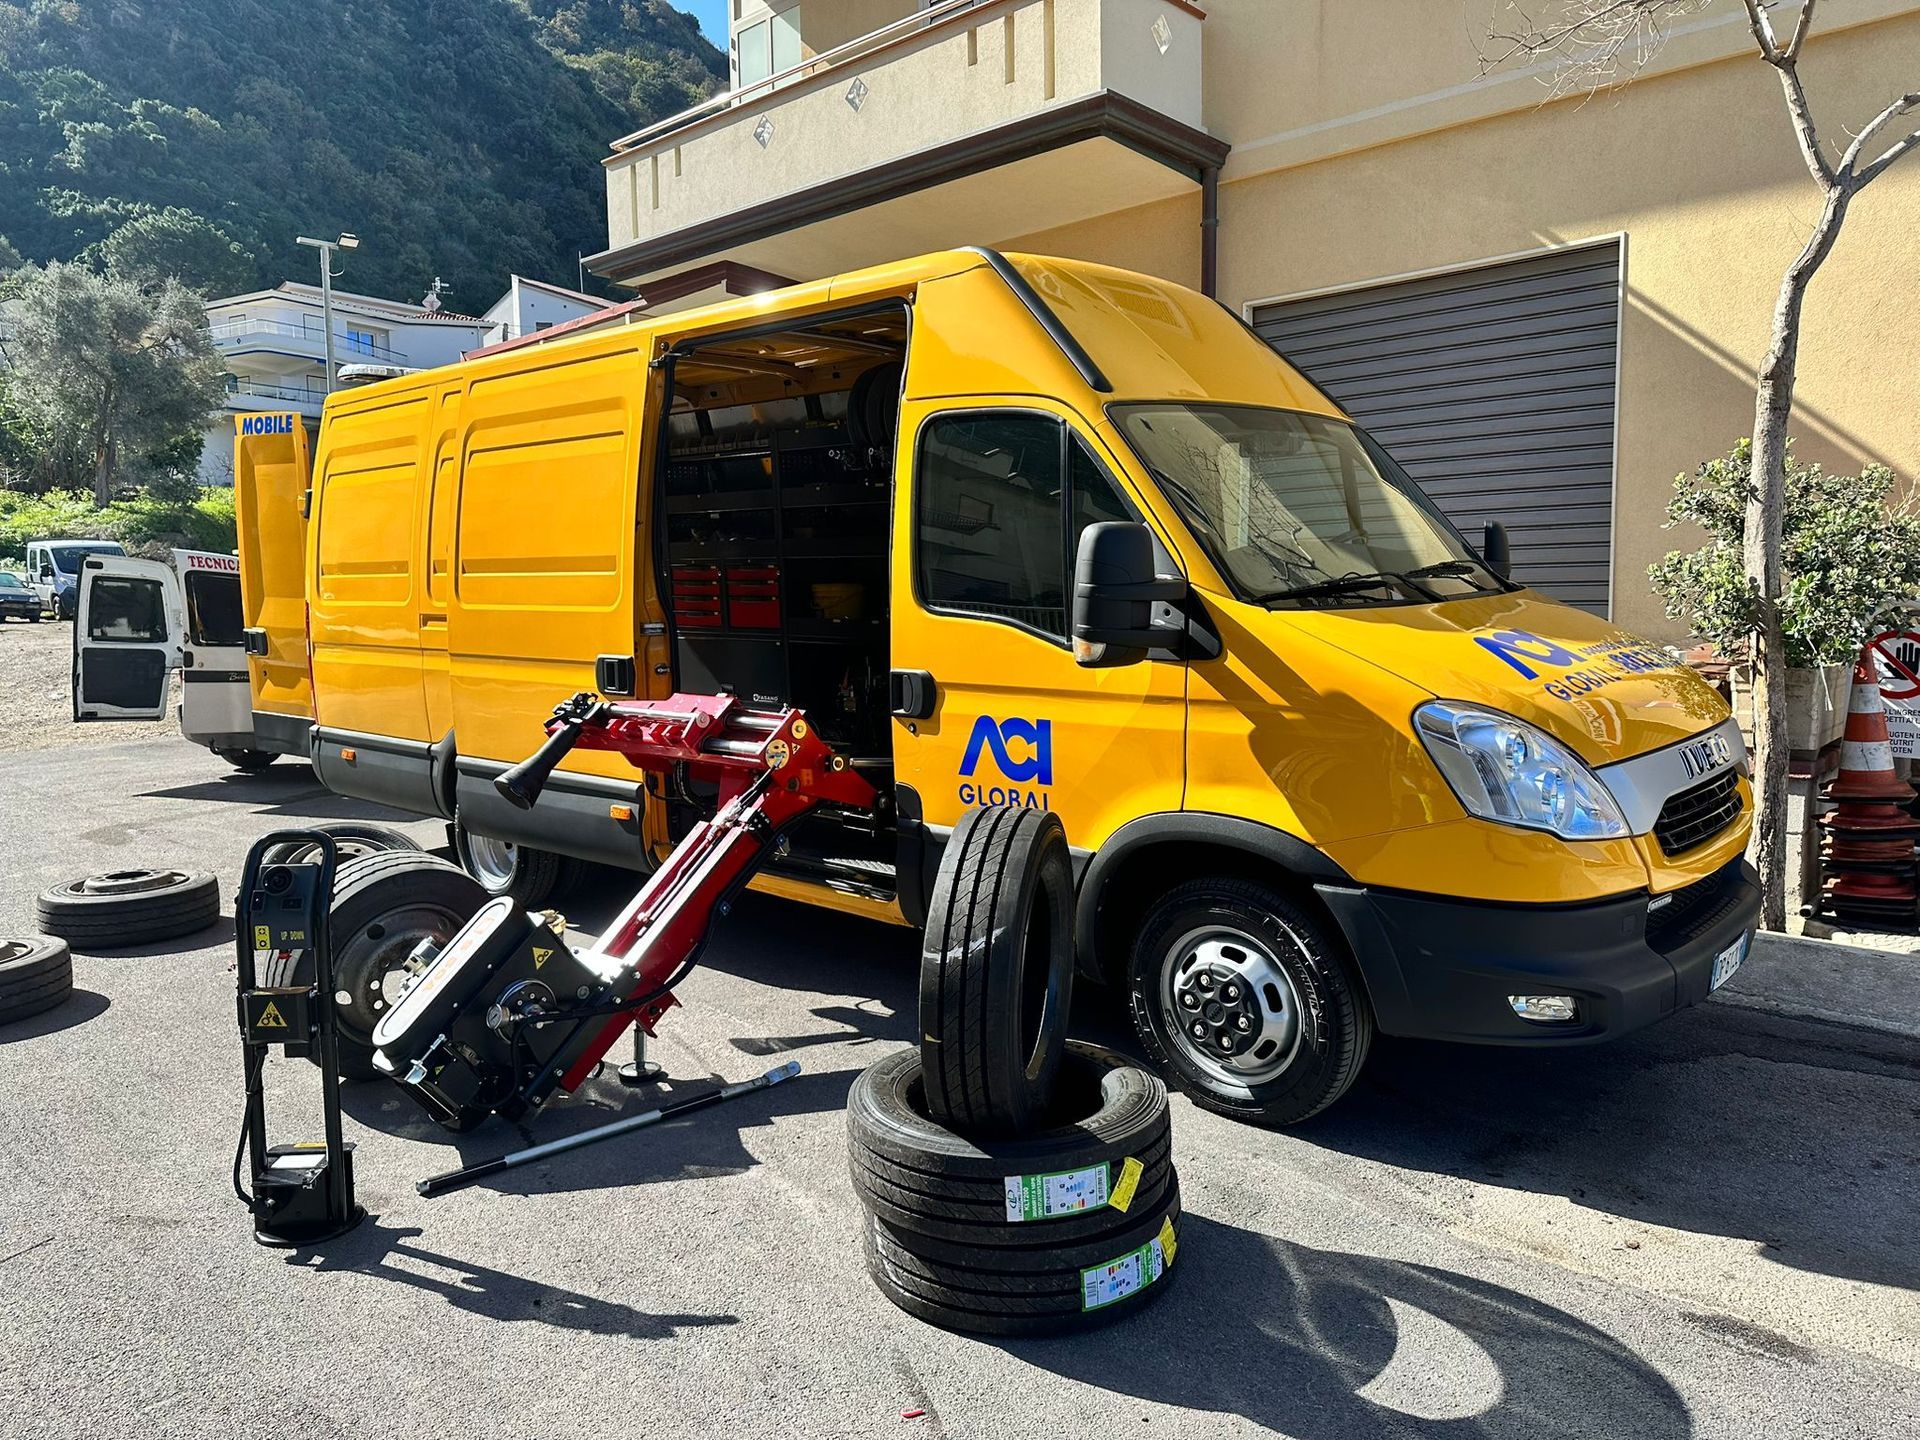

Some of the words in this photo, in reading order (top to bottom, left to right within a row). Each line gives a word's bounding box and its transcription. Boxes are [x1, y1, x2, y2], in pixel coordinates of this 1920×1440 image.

[242, 415, 293, 435] MOBILE
[1474, 627, 1588, 681] ACI
[1543, 666, 1622, 701] GLOBAL
[958, 714, 1053, 786] ACI
[1678, 733, 1731, 779] IVECO
